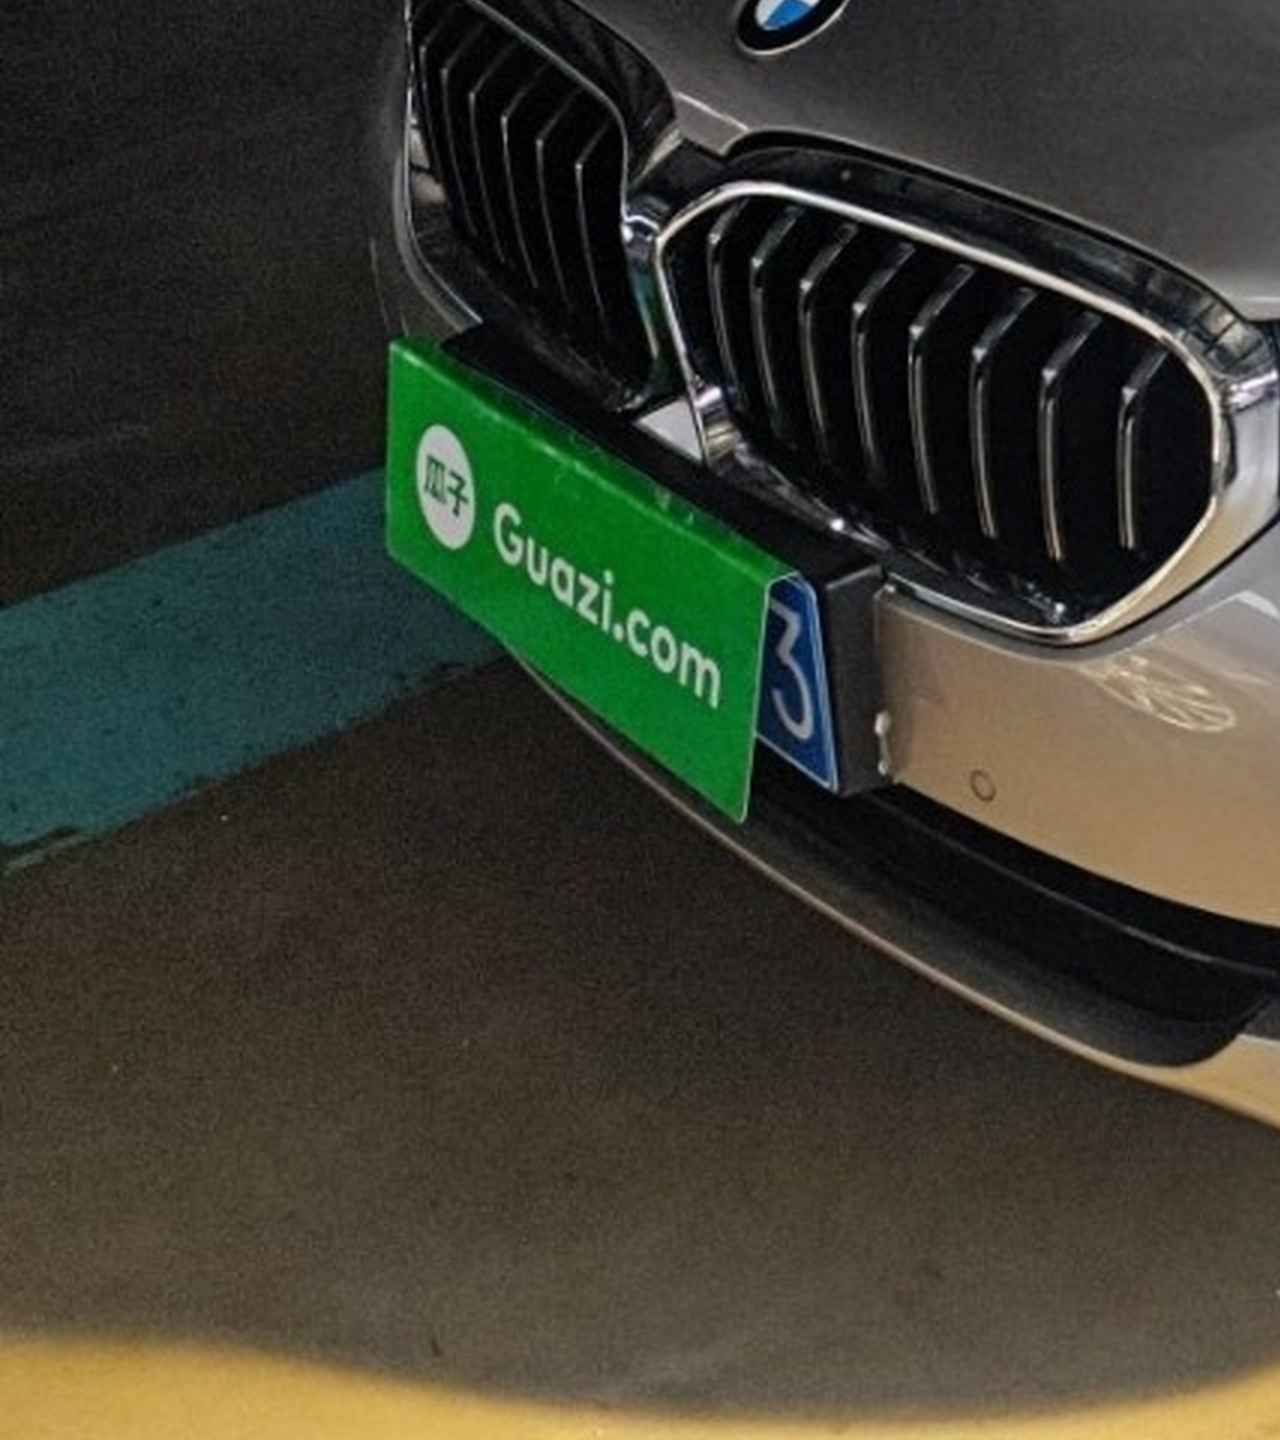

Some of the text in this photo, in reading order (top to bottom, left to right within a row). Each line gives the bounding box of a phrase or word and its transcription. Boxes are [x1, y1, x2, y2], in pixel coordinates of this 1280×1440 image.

[424, 453, 470, 518] 瓜子
[493, 502, 722, 709] Guazi.com
[769, 596, 815, 741] 3
